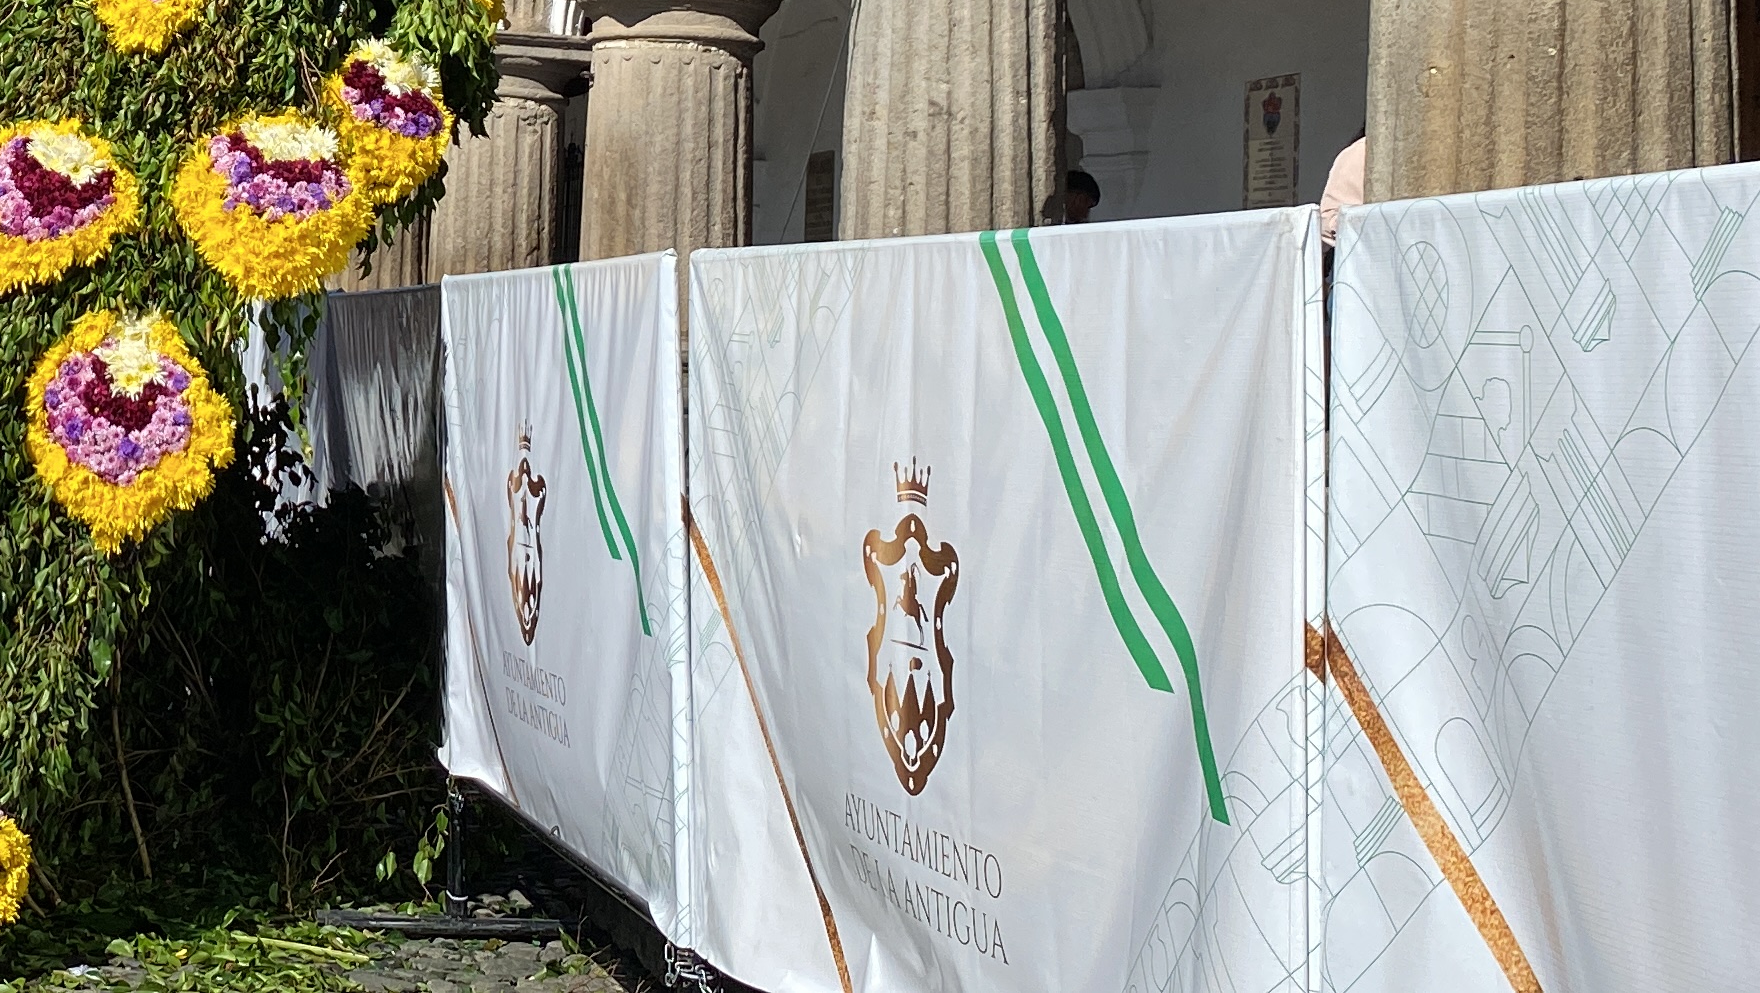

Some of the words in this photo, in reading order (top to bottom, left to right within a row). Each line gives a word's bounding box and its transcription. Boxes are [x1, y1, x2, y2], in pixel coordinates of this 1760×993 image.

[502, 650, 566, 706] AYUNTAMIENTO
[505, 686, 518, 718] DE
[517, 692, 530, 725] LA
[529, 702, 571, 748] ANTIGUA
[844, 792, 1002, 899] AYUNTAMIENTO
[849, 843, 878, 892] DE
[874, 859, 902, 910] LA
[904, 876, 1010, 966] ANTIGUA
